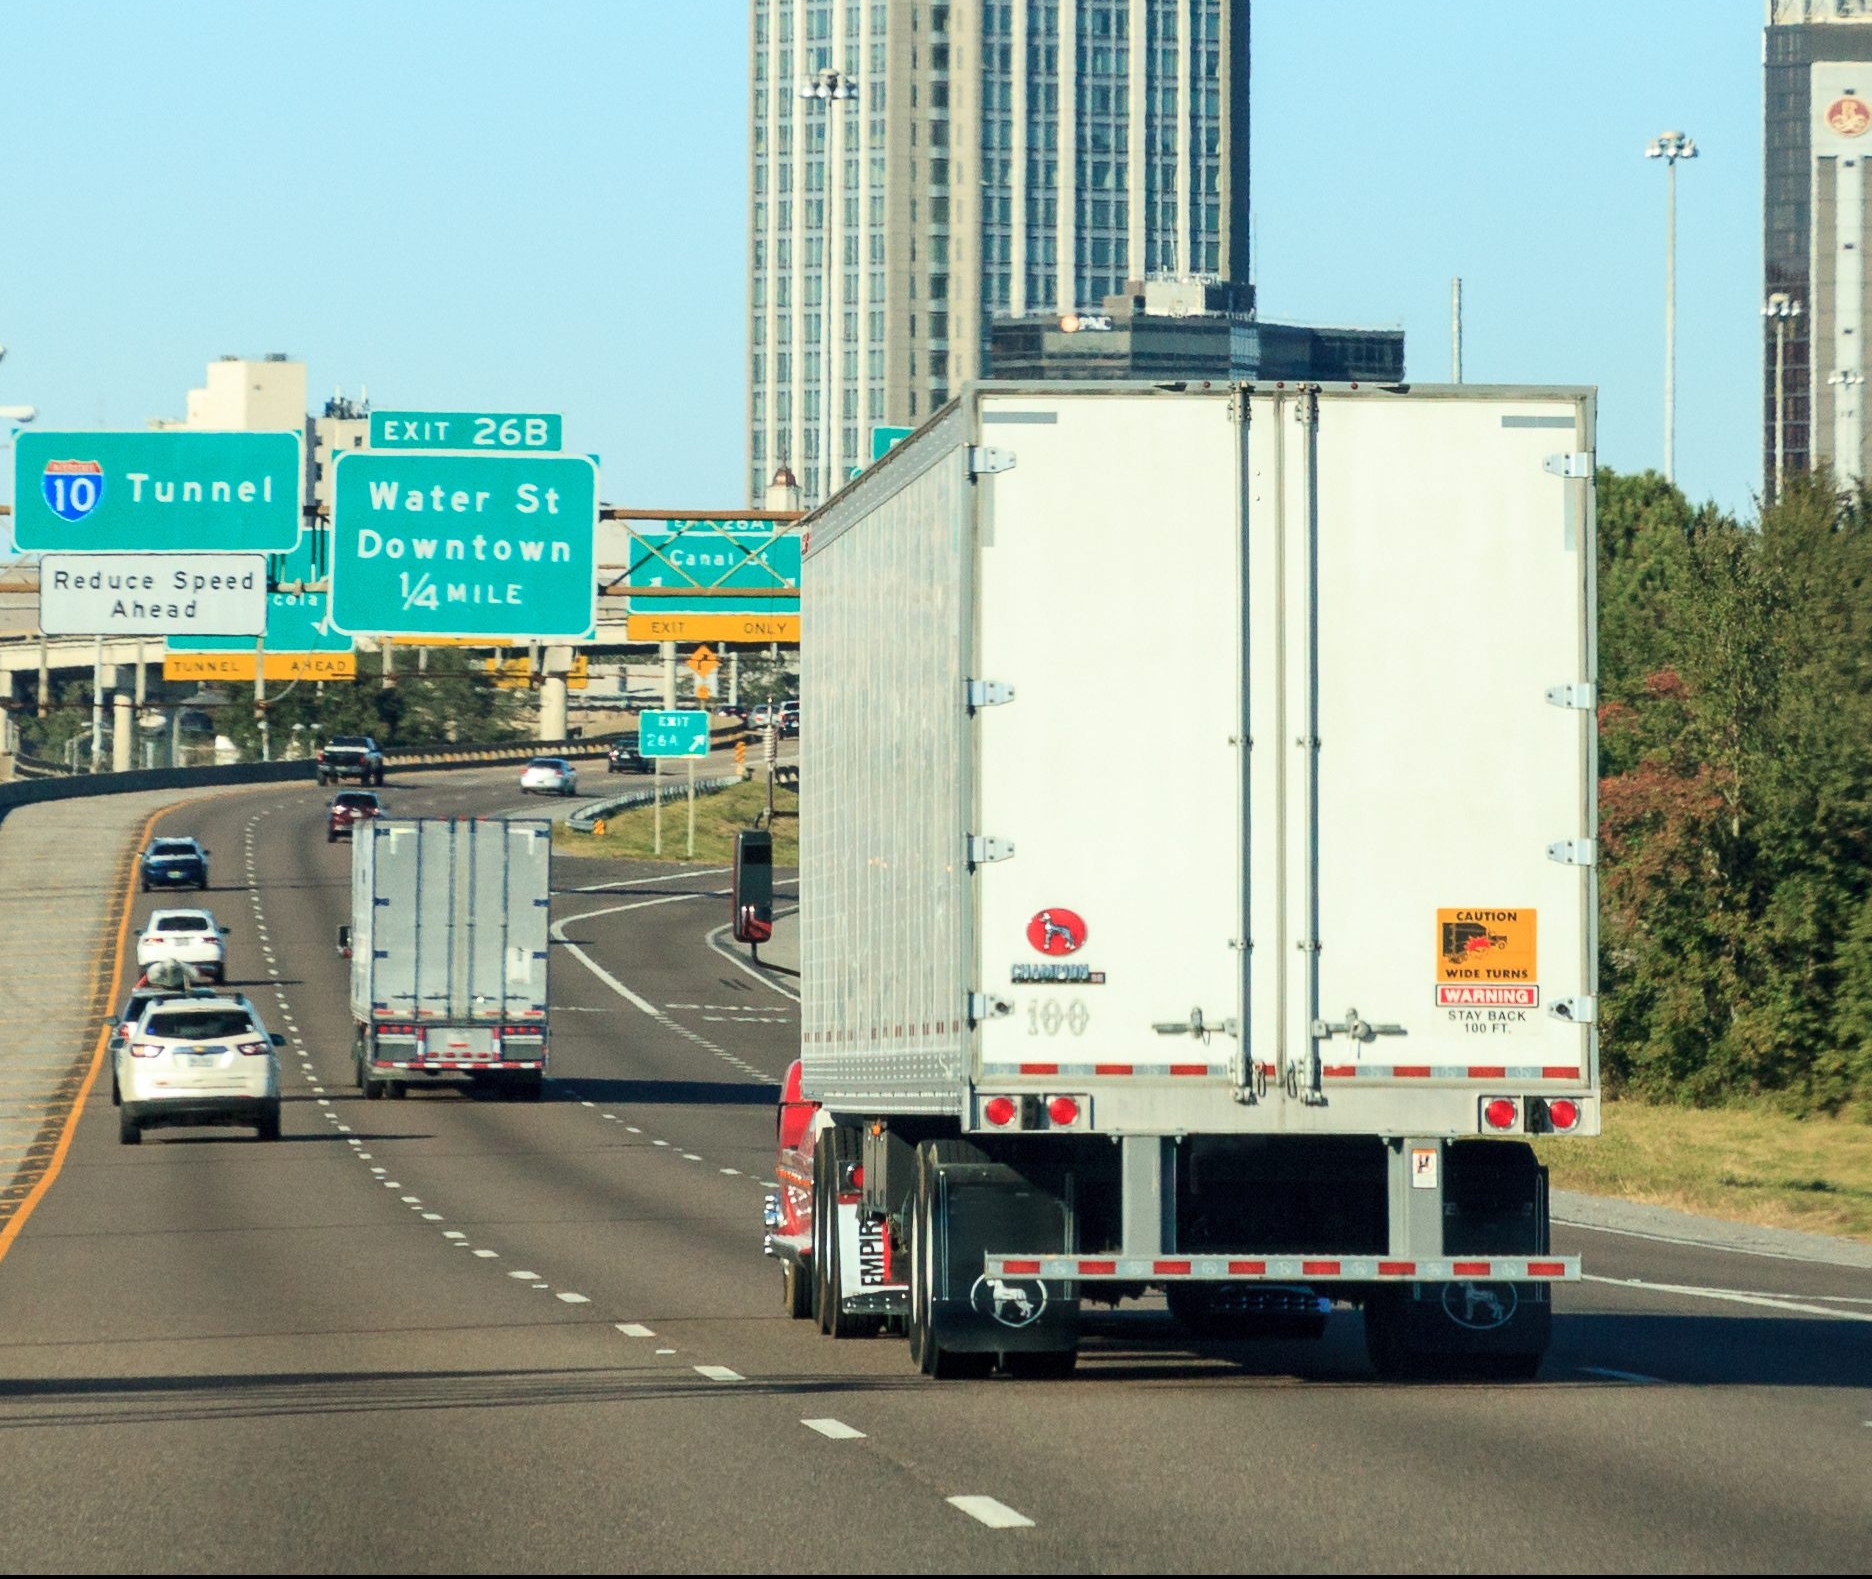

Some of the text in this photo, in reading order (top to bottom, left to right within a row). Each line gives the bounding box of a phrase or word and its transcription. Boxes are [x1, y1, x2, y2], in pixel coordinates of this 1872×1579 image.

[384, 417, 548, 446] EXIT 26B
[54, 472, 272, 512] 10 Tunnel
[369, 481, 560, 514] Water St
[357, 529, 571, 562] Downtown
[669, 549, 734, 566] Canal
[54, 571, 254, 593] Reduce Speed
[447, 583, 523, 605] MILE
[111, 600, 197, 618] Ahead
[651, 621, 787, 635] EXIT ONLY
[173, 660, 346, 672] TUNNEL AHEAD
[658, 716, 690, 727] EXIT
[646, 733, 678, 747] 26A
[1456, 911, 1518, 922] CAUTION
[1445, 969, 1529, 979] WIDE TURNS
[1444, 988, 1529, 1004] WARNING
[1448, 1010, 1527, 1022] STAY BACK
[1464, 1023, 1512, 1035] 100 FT.
